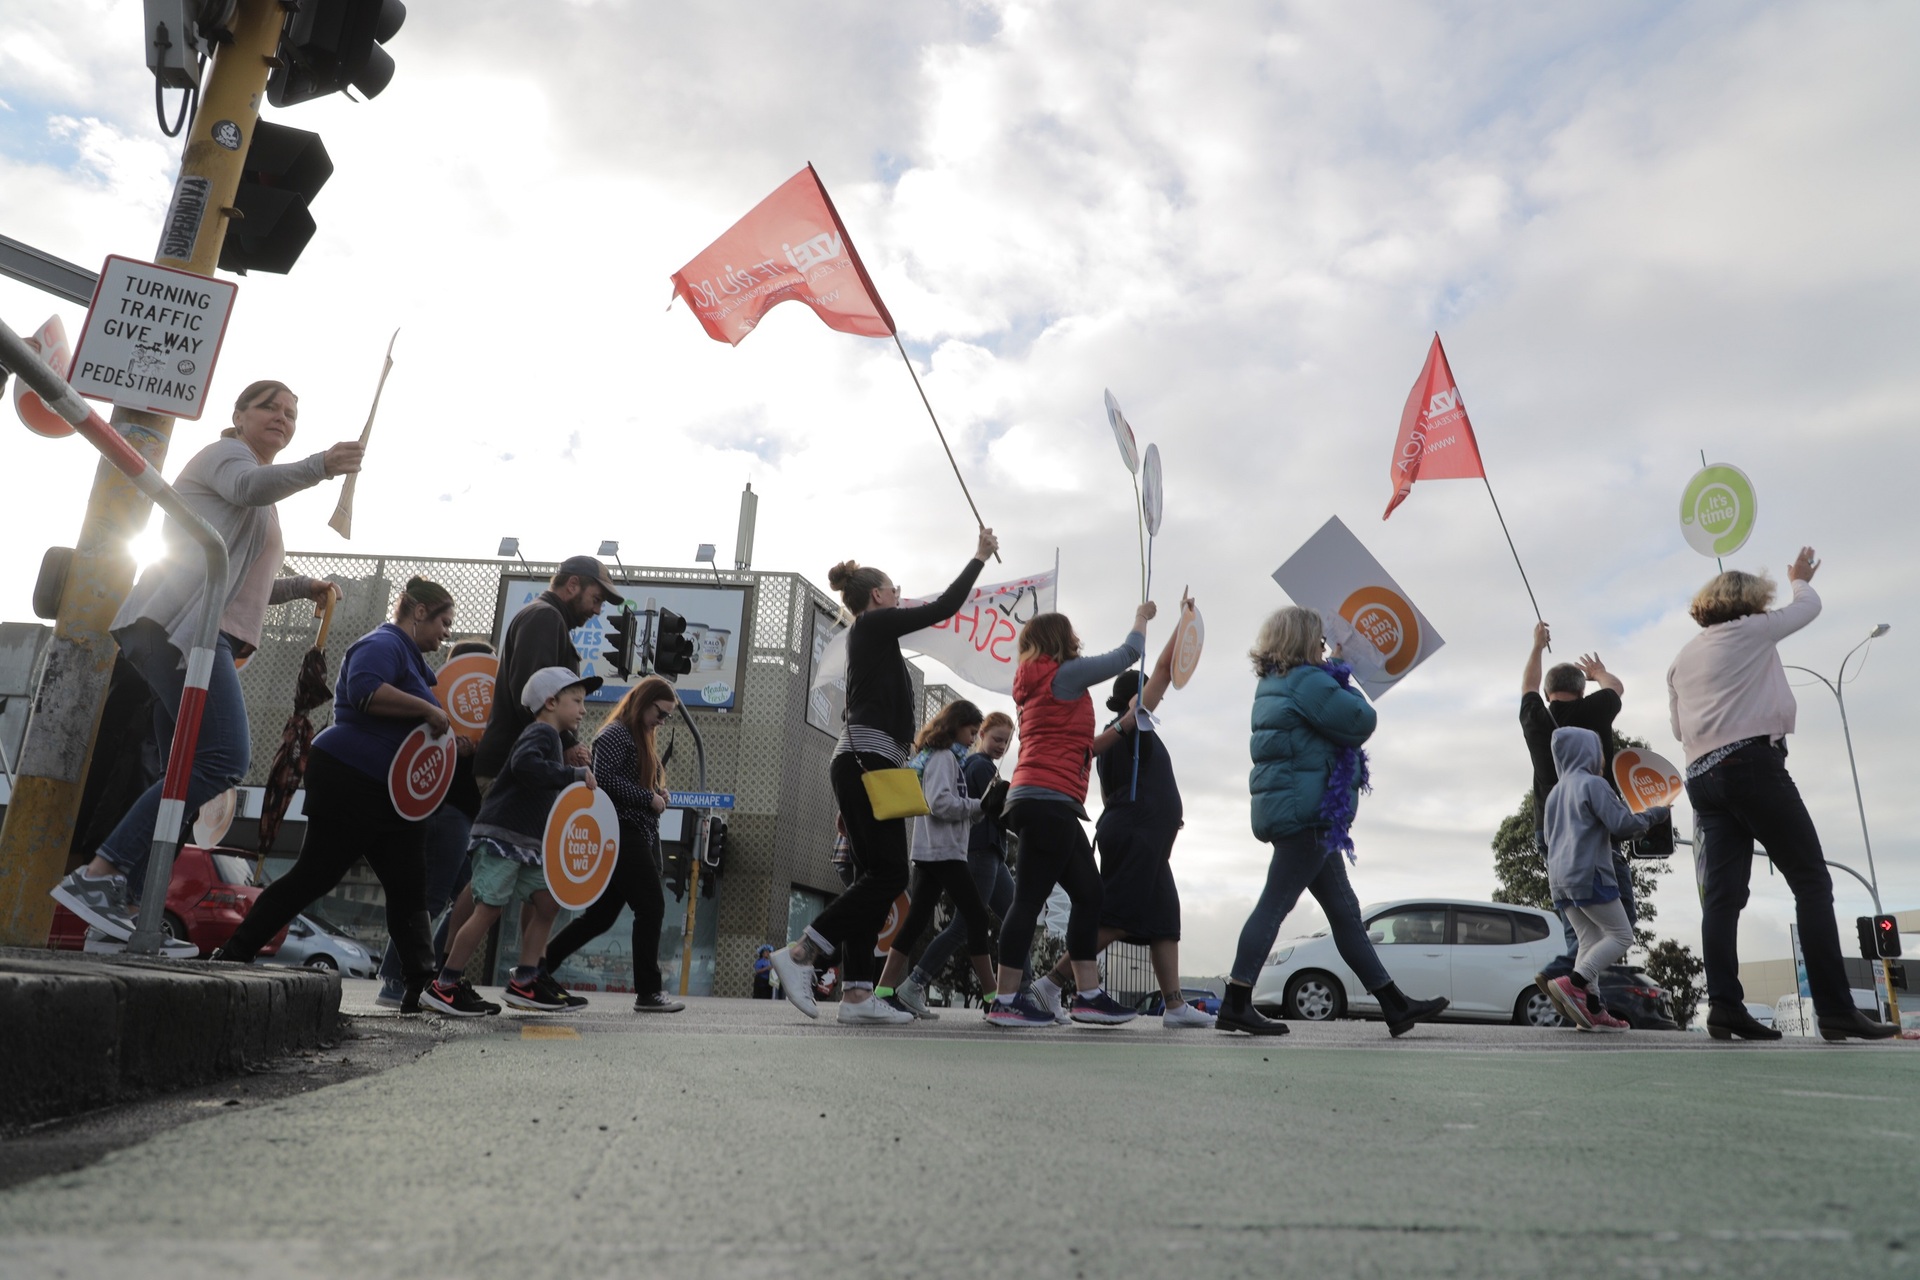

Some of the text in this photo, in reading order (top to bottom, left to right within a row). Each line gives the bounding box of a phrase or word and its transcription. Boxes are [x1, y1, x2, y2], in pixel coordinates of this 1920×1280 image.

[163, 179, 208, 257] SUPERNOVA
[126, 275, 211, 310] TURNING
[120, 298, 203, 331] TRAFFIC
[104, 318, 152, 343] GIVE
[164, 331, 203, 355] WAY
[81, 361, 197, 402] PEDESTRIANS
[1708, 494, 1728, 510] It's
[1700, 506, 1734, 525] time
[1371, 618, 1392, 635] tae
[1375, 627, 1400, 647] Kua
[477, 678, 491, 704] Kua
[703, 682, 730, 698] Meadow
[456, 693, 472, 715] wā
[467, 683, 484, 721] tae te
[412, 749, 443, 784] time
[420, 769, 436, 789] It's
[1633, 775, 1652, 787] Kua
[1640, 782, 1666, 795] tae te
[668, 793, 721, 806] ARANGAHAPE
[567, 823, 589, 840] Kua
[568, 841, 586, 854] tae
[588, 840, 599, 854] te
[573, 855, 589, 871] wā
